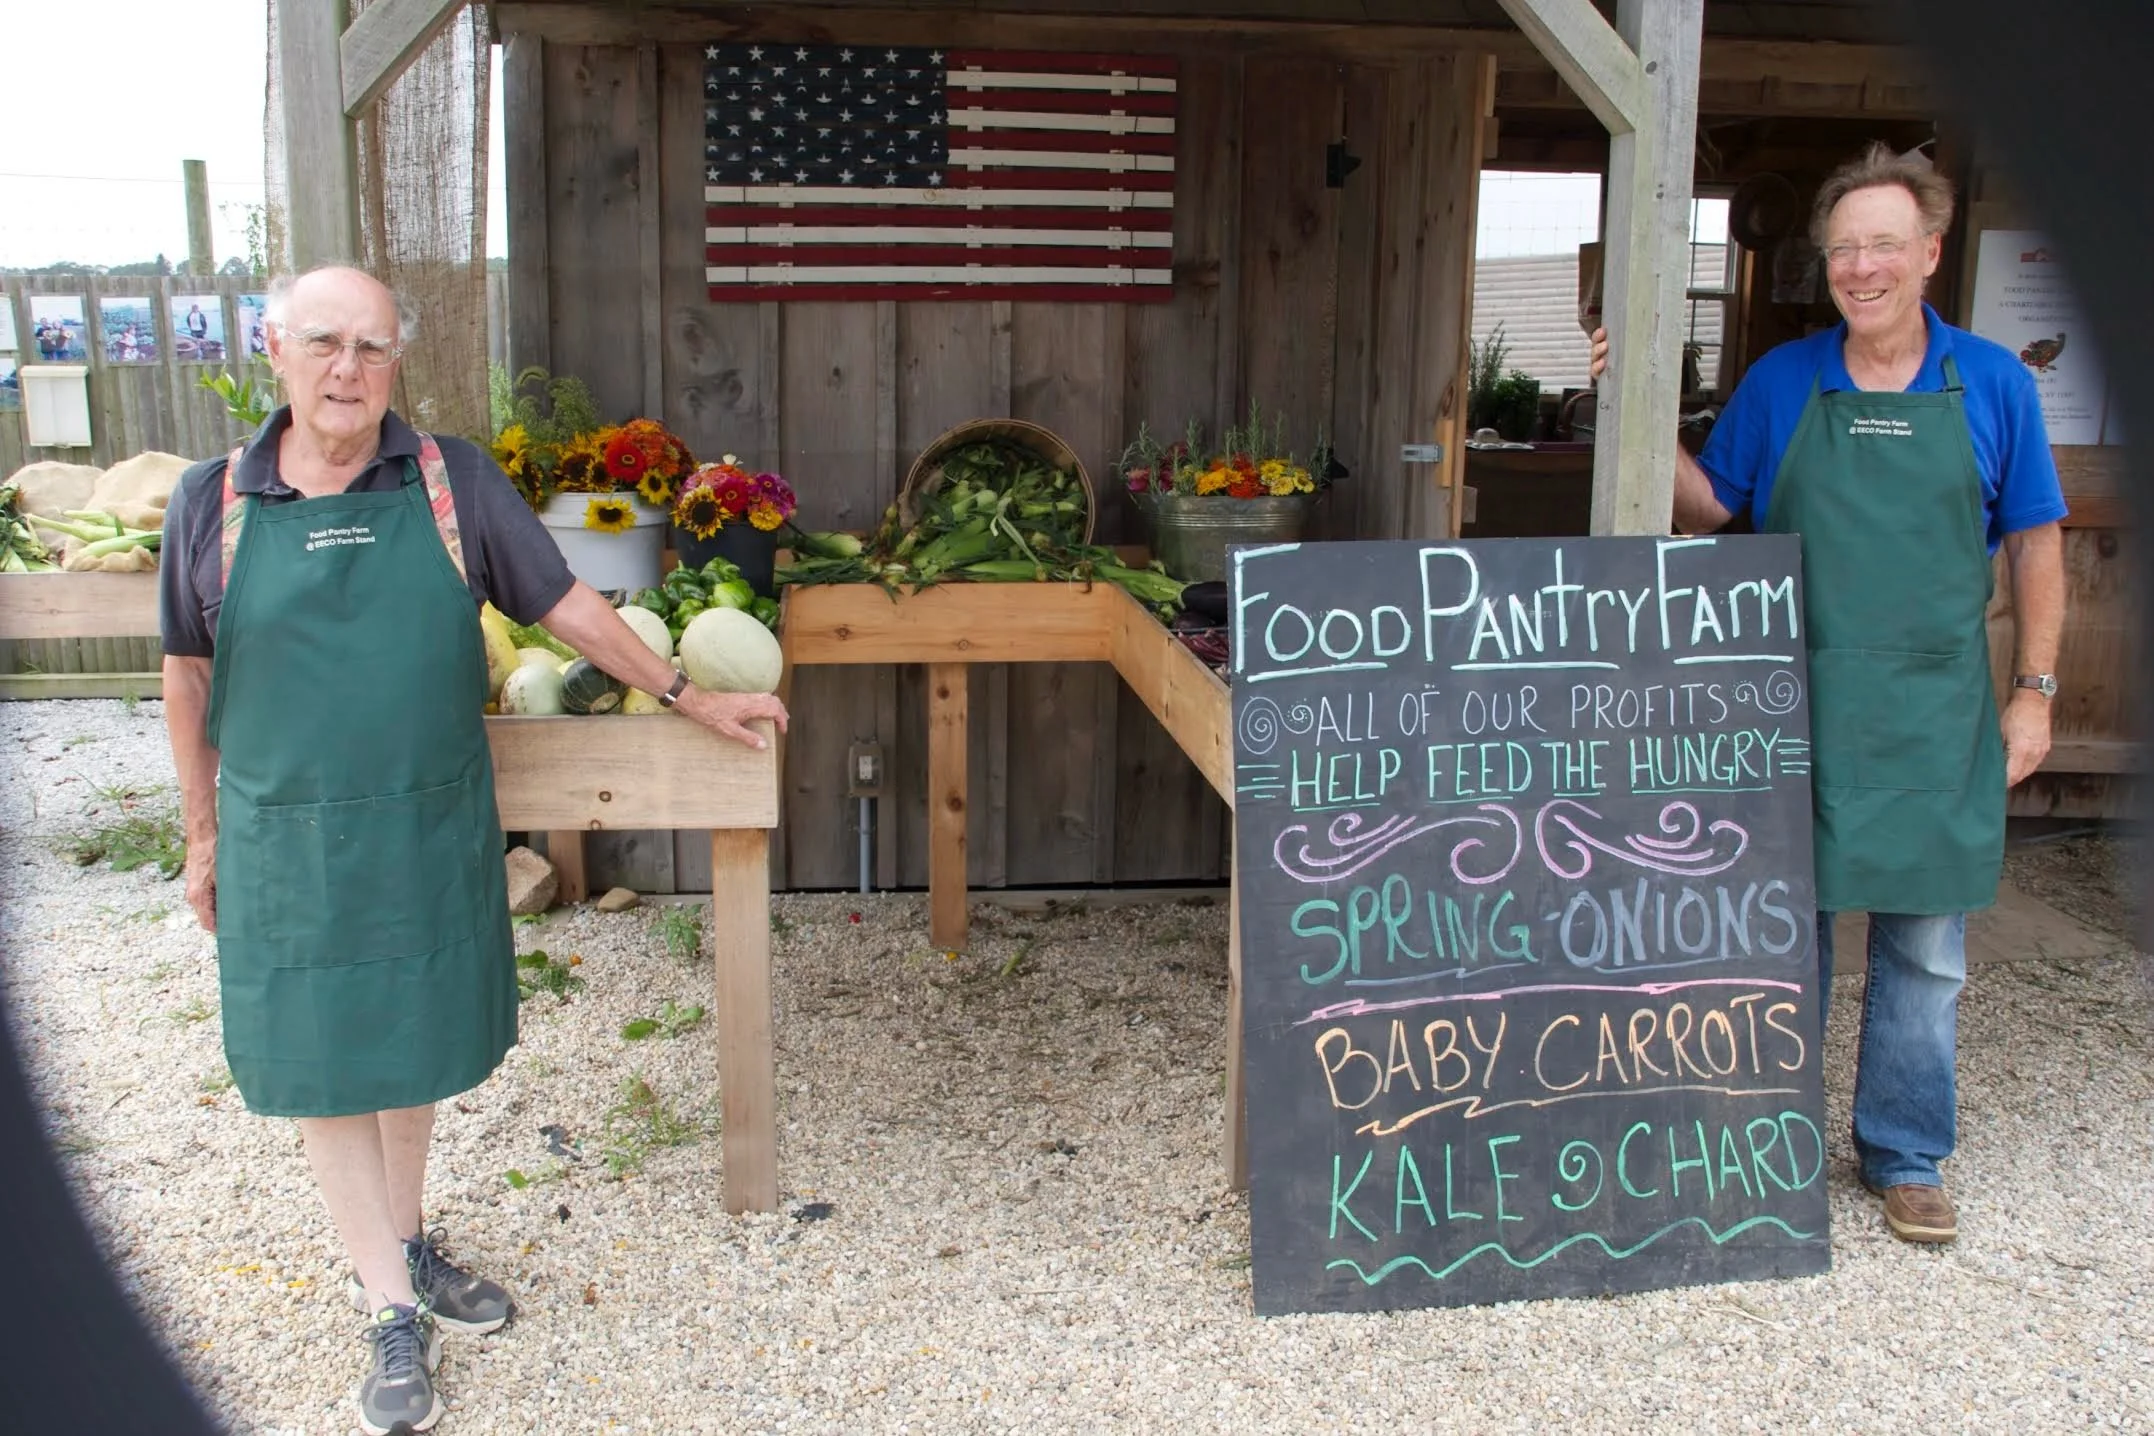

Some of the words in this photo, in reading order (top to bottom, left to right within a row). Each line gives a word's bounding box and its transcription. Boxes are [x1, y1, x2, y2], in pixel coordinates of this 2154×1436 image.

[1849, 426, 1856, 435] @
[1875, 427, 1893, 435] Farm
[1893, 428, 1912, 436] Stand
[1870, 418, 1891, 427] Pantry
[306, 542, 314, 551] @
[314, 538, 336, 548] EECO
[355, 535, 376, 544] Stand
[309, 530, 328, 539] Food
[328, 528, 351, 536] Pantry
[352, 526, 370, 534] Farm
[1234, 543, 1411, 673] FOOD
[1316, 692, 1380, 746] ALL
[1400, 688, 1440, 735] OF
[1463, 685, 1553, 735] OUR
[1571, 682, 1729, 729] PROFITS
[1291, 747, 1401, 806] HELP
[1428, 742, 1533, 798] FEED
[1541, 741, 1610, 791] THE
[1629, 728, 1780, 788] HUNGRY
[1291, 874, 1538, 986] SPRING
[1315, 1011, 1507, 1109] BABY
[1535, 994, 1805, 1091] CARROTS
[1330, 1135, 1524, 1241] KALE
[1617, 1111, 1823, 1200] CHARD
